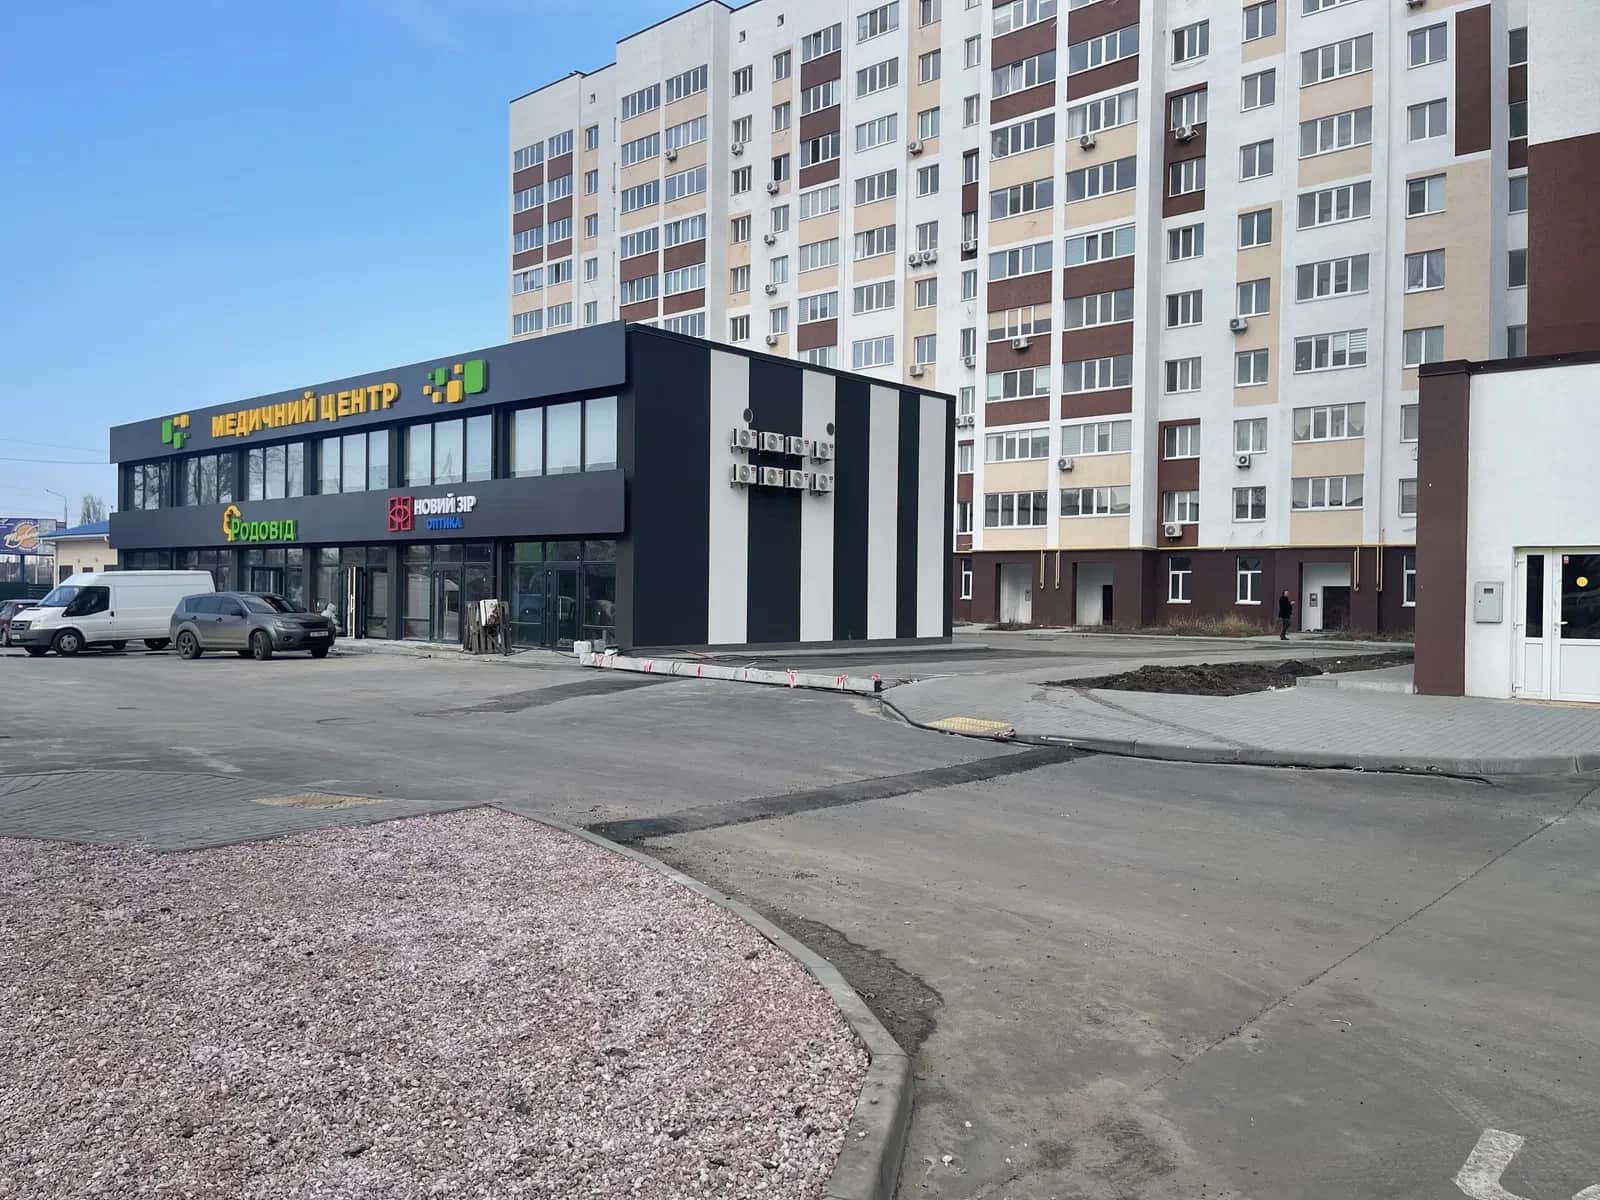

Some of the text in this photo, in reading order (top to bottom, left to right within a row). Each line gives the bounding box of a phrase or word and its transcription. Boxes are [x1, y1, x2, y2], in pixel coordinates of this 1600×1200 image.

[211, 382, 399, 438] МЕДИЧНИЙ ЦЕНТР
[413, 492, 477, 515] НОВИЙ ЗІР
[426, 515, 463, 530] ОПТИКА
